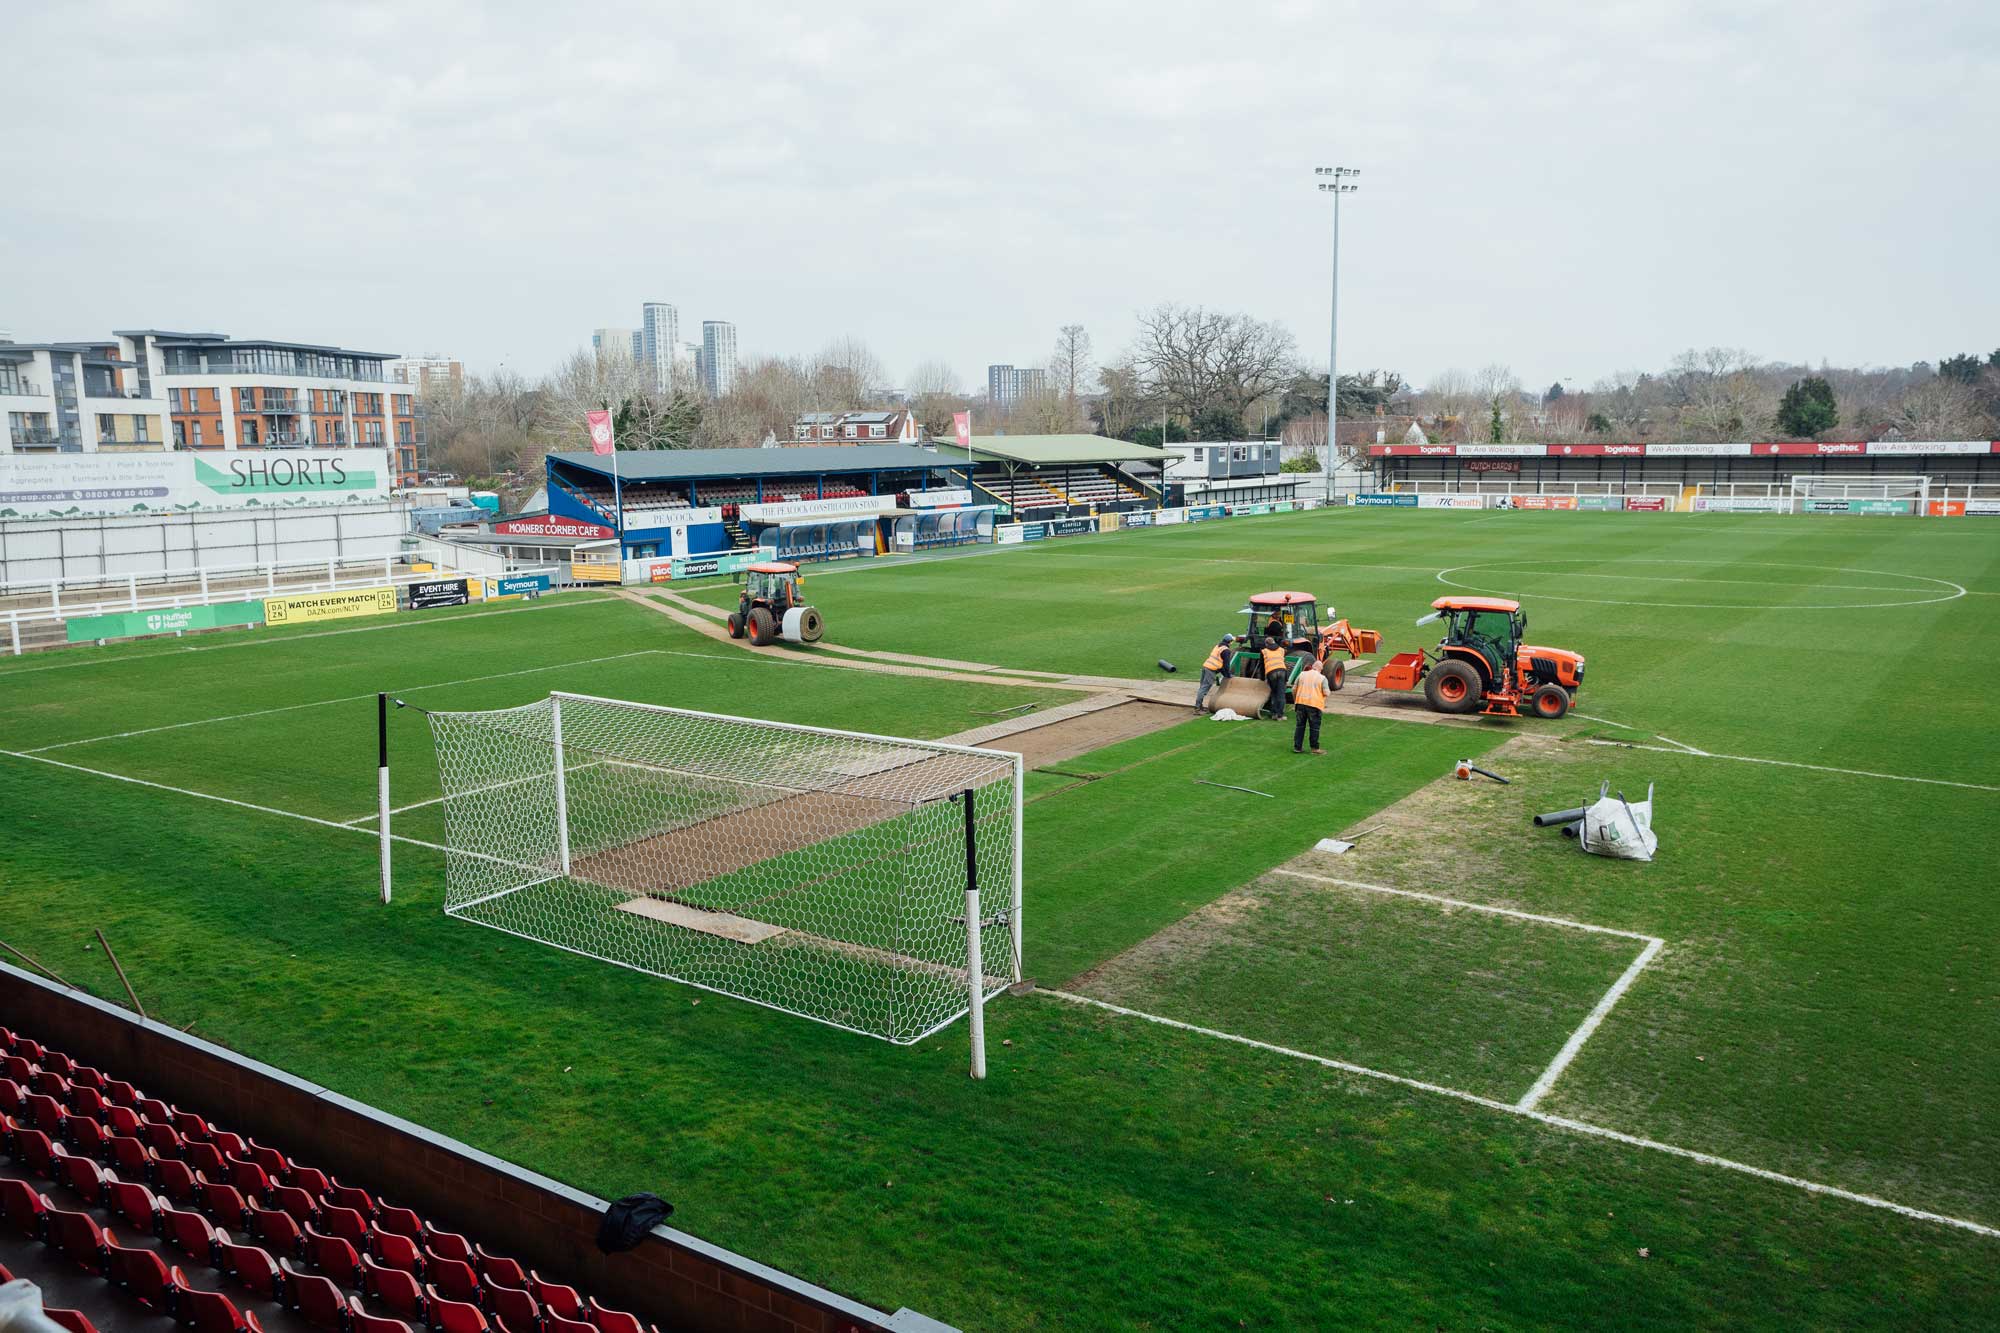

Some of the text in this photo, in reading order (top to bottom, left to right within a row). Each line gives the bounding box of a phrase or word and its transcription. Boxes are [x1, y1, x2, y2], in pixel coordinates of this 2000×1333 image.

[230, 458, 346, 487] SHORTS
[1356, 496, 1392, 505] Seymours
[777, 505, 808, 516] PEACOCK
[809, 502, 860, 514] CONSTRUCTION
[860, 500, 880, 509] STAND
[653, 513, 694, 524] PEACOCK
[508, 524, 544, 533] MOANERS
[545, 525, 577, 535] CORNER
[677, 562, 718, 573] enterprise
[419, 585, 442, 594] EVENT
[443, 583, 459, 591] HIRE
[503, 580, 539, 591] Seymours
[288, 594, 376, 609] WATCH EVERY MATCH
[162, 611, 193, 621] Nuffield
[306, 604, 360, 617] DAZN.com/NLTV
[163, 620, 189, 629] Health
